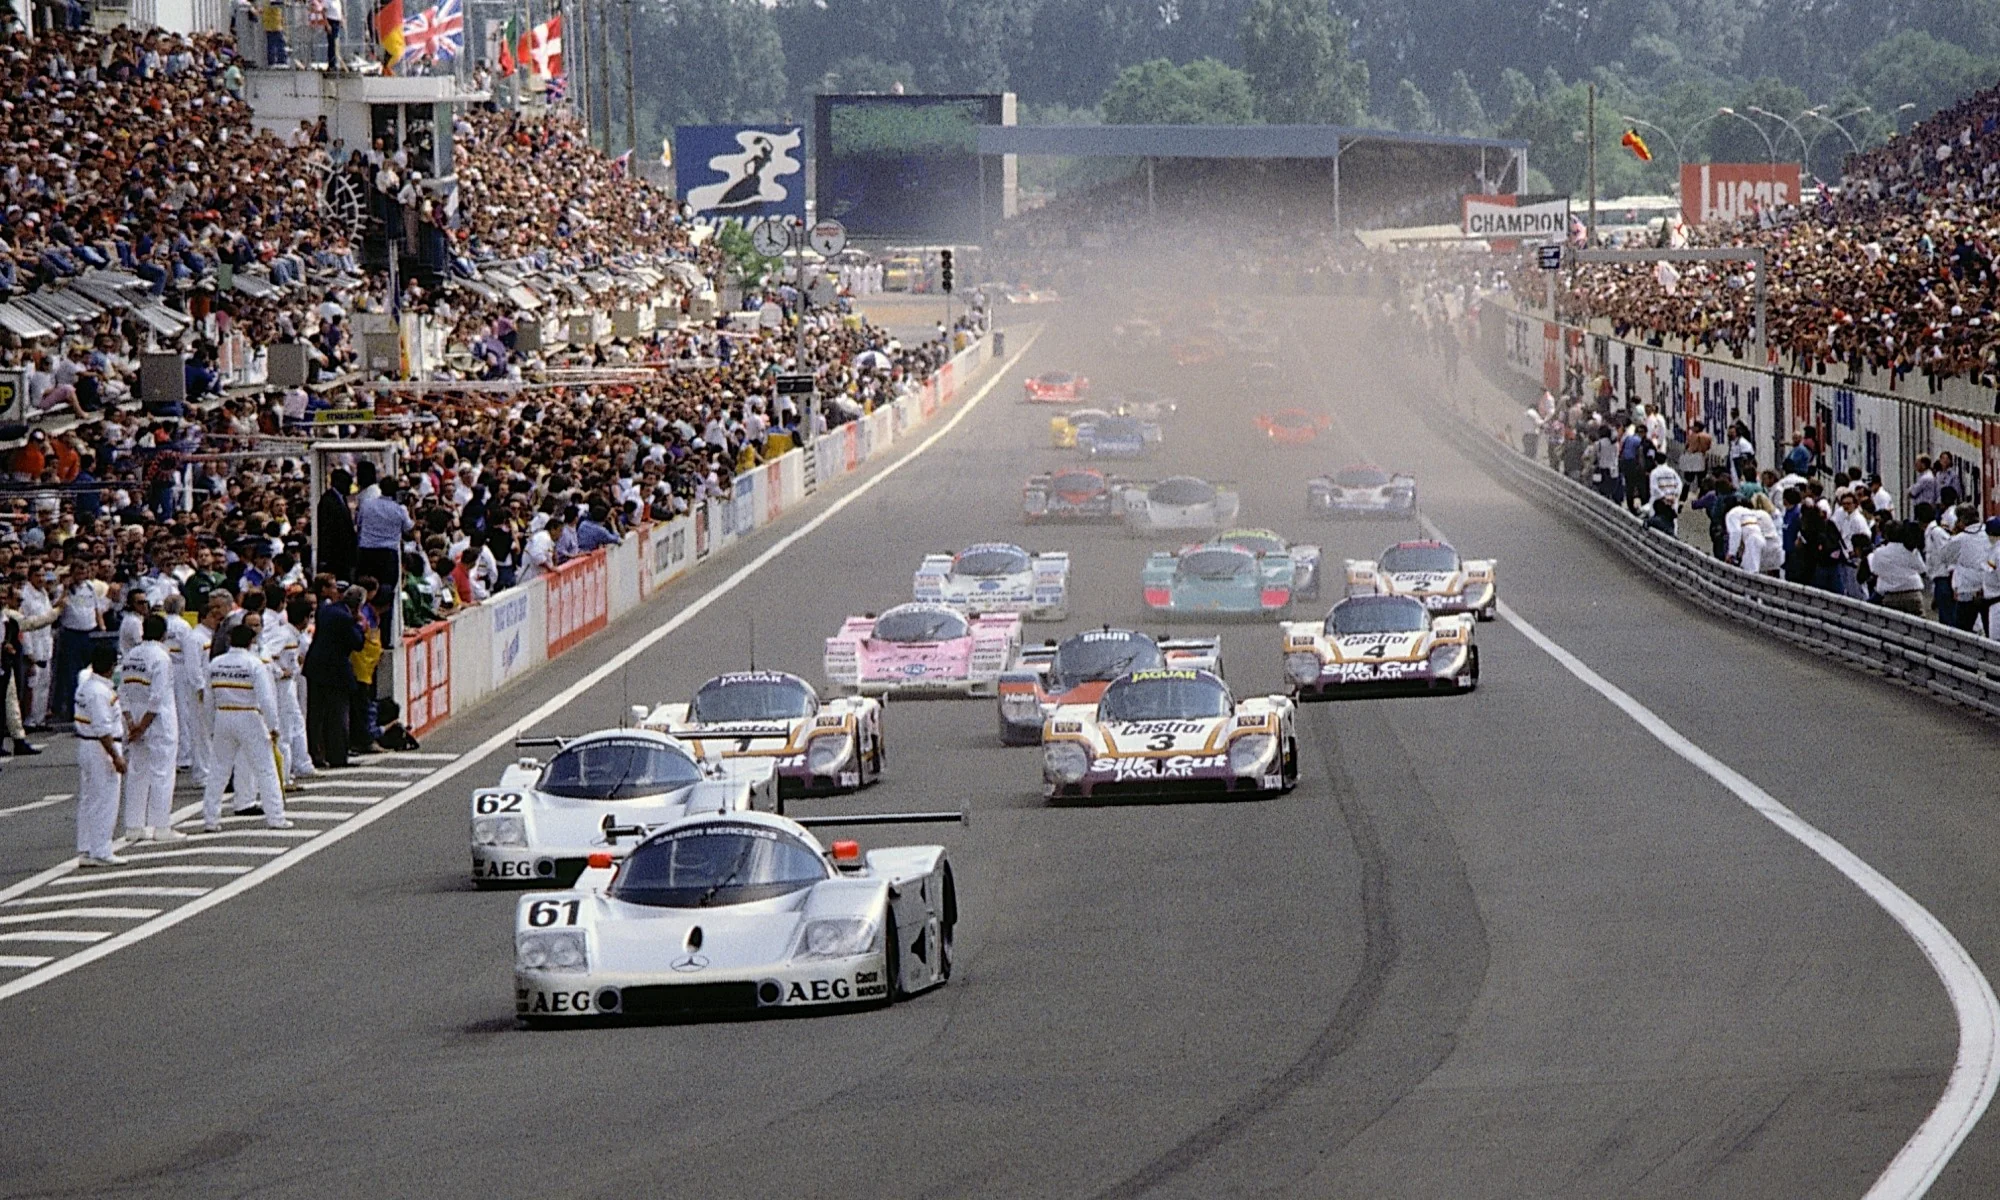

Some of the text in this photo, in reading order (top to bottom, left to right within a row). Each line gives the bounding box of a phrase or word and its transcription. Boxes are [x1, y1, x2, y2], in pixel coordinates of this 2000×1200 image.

[1470, 213, 1564, 233] CHAMPION
[1343, 633, 1410, 647] Castrol
[1363, 644, 1386, 658] 4
[1321, 660, 1430, 675] Silk Cut
[720, 675, 782, 686] JAGUAR
[1131, 670, 1197, 684] JAGUAR
[1339, 670, 1403, 684] JAGUAR
[1120, 721, 1206, 736] Castrol
[611, 740, 665, 751] MERCEDES
[1146, 734, 1176, 751] 3
[1091, 754, 1229, 772] Silk Cut
[1114, 766, 1194, 782] JAGUAR
[476, 792, 523, 815] 62
[653, 827, 778, 846] SAUBER MERCEDES
[486, 860, 532, 879] AEG
[528, 899, 581, 927] 61
[786, 978, 851, 1002] AEG
[531, 990, 591, 1012] AEG
